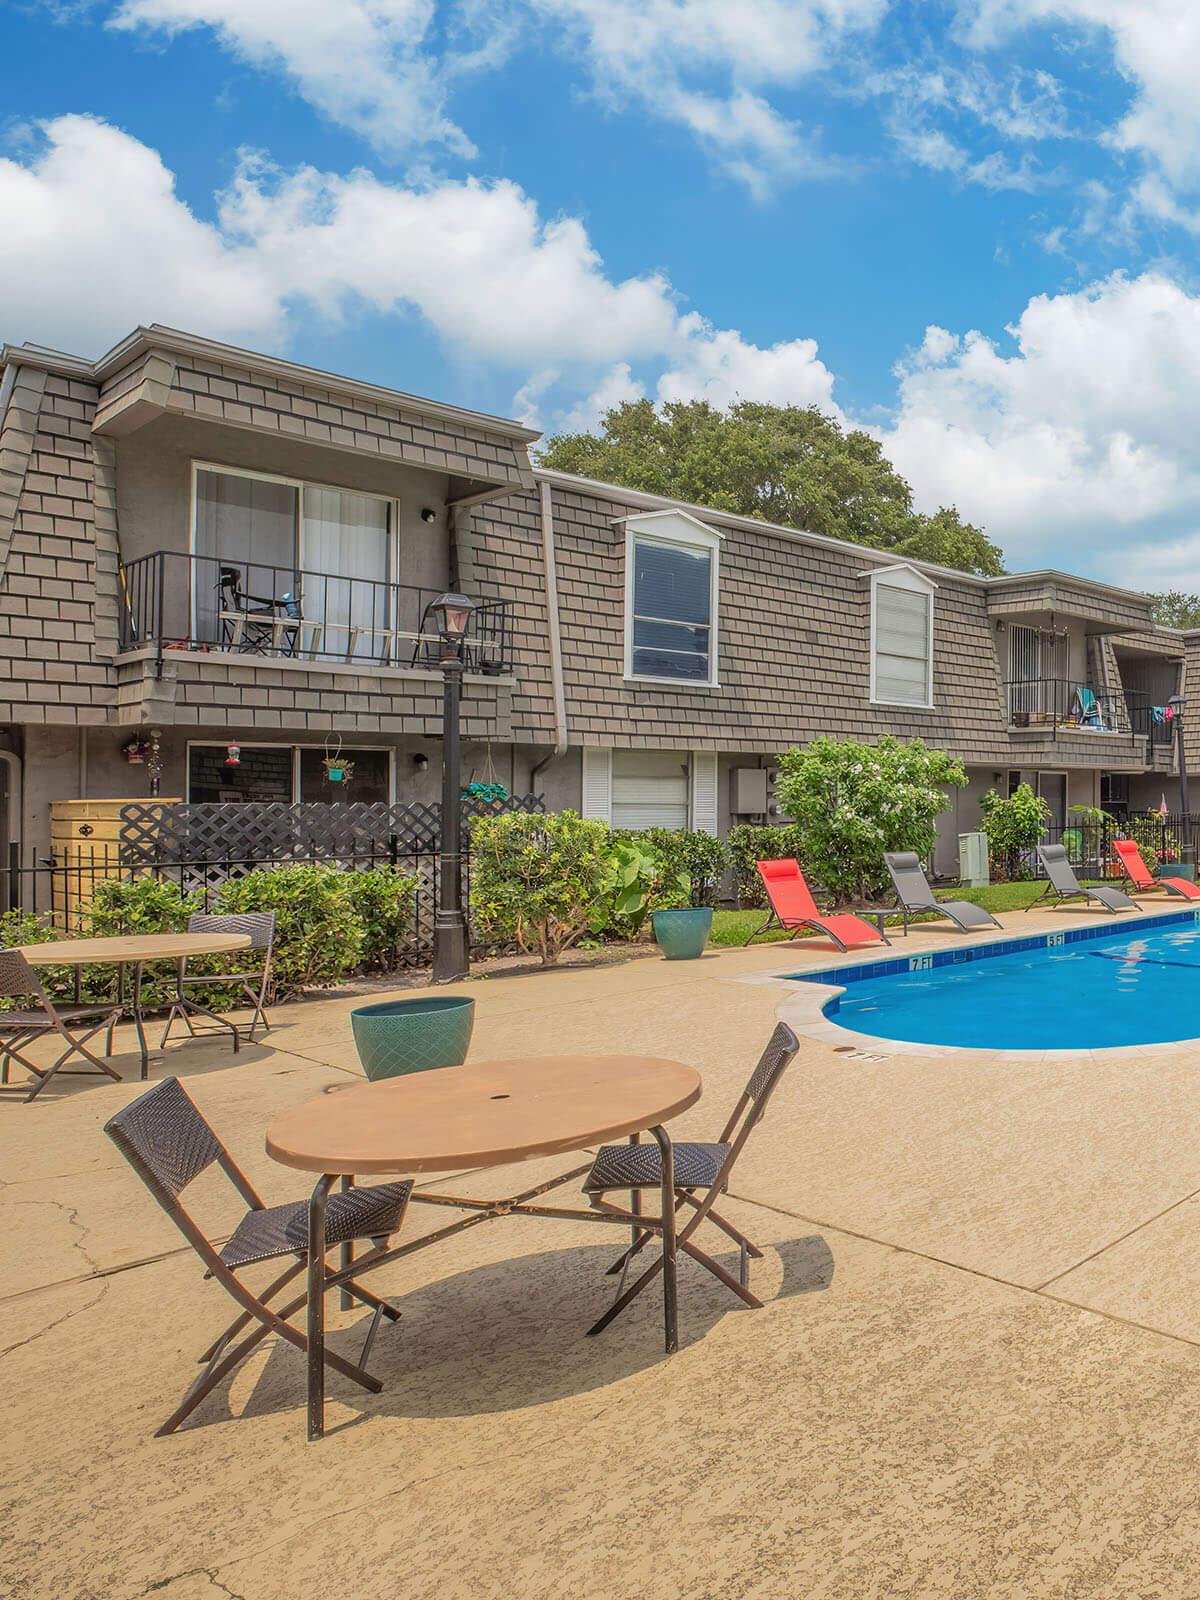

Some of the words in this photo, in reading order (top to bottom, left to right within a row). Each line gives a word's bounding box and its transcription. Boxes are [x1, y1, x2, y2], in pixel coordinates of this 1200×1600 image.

[1049, 936, 1055, 946] 5
[1056, 934, 1064, 945] FT
[912, 959, 918, 971] 7
[921, 956, 931, 969] FT
